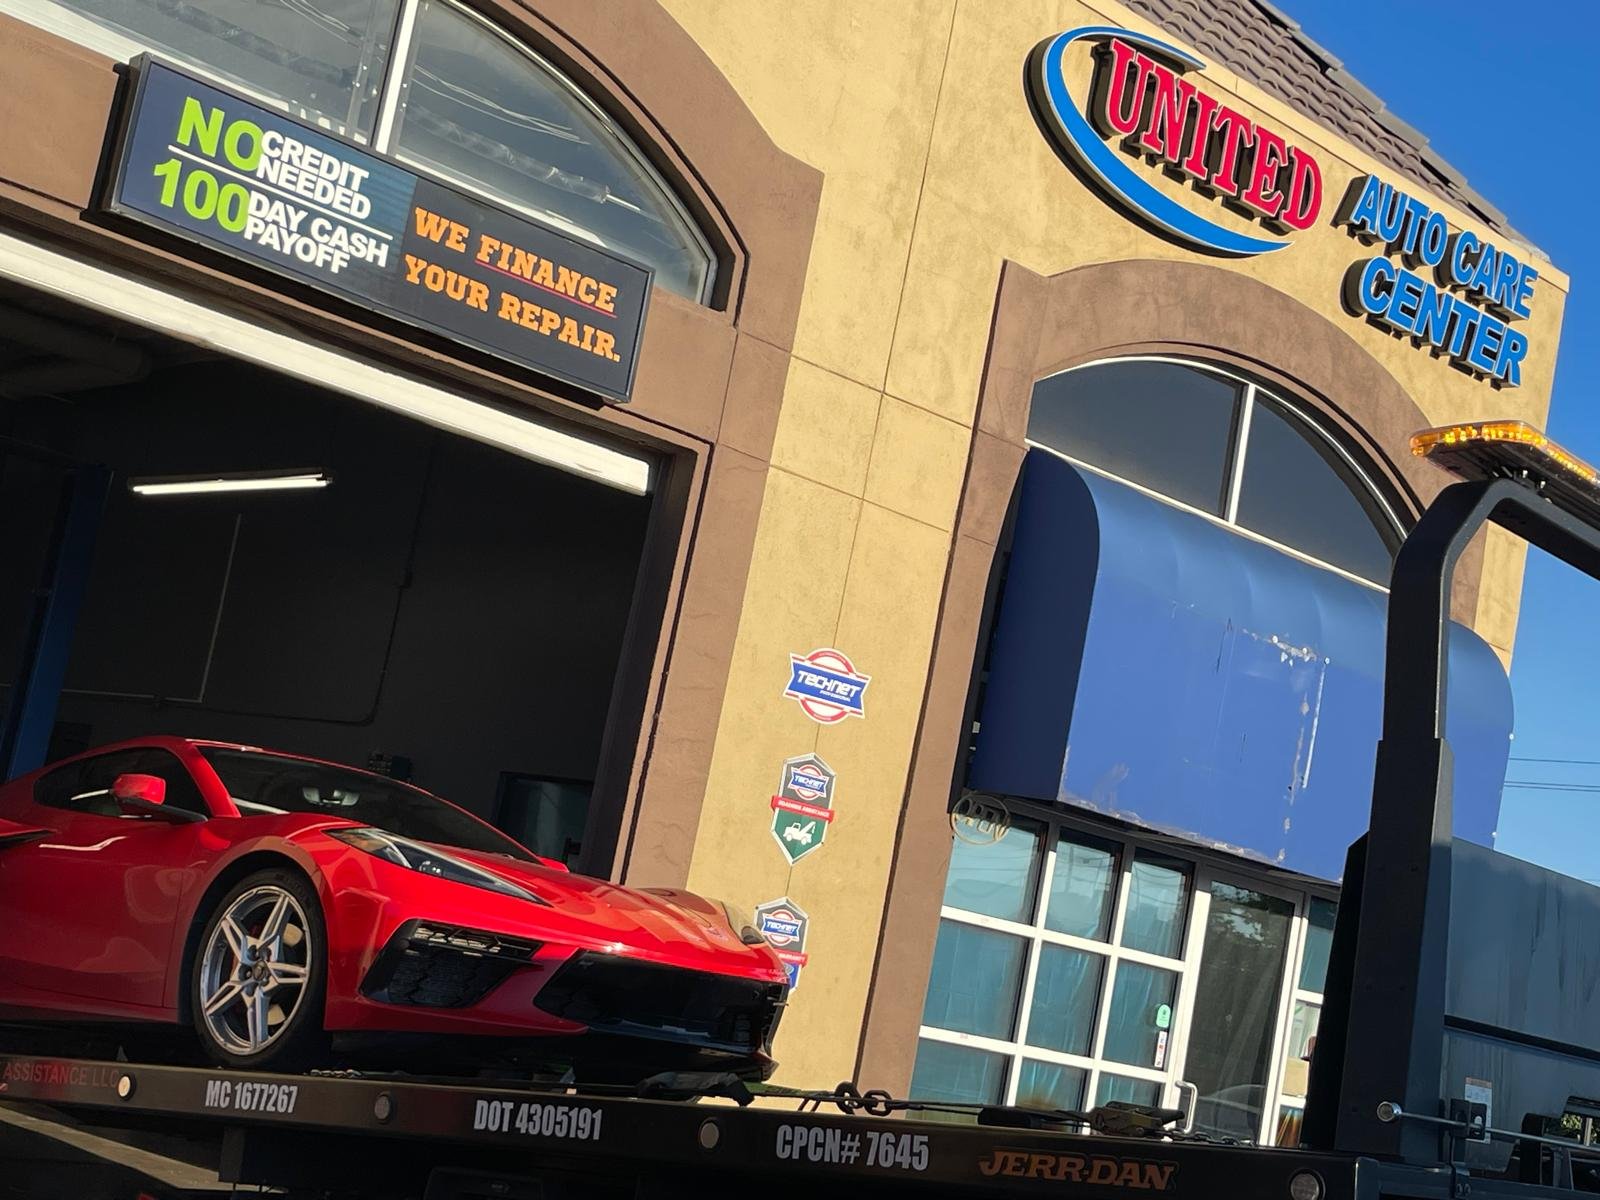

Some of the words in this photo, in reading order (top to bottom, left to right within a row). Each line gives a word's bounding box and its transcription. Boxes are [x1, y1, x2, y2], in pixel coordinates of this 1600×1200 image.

[177, 96, 263, 172] NO
[261, 129, 369, 191] CREDIT
[1105, 38, 1323, 231] UNITED
[153, 159, 250, 233] 100
[256, 154, 372, 220] NEEDED
[243, 217, 351, 274] PAYOFF
[248, 190, 308, 231] DAY
[311, 217, 390, 268] CASH
[414, 206, 470, 253] WE
[476, 233, 618, 313] FINANCE
[1352, 174, 1448, 267] AUTO
[1449, 229, 1539, 321] CARE
[404, 254, 489, 312] YOUR
[497, 292, 621, 362] REPAIR.
[1360, 256, 1529, 389] CENTER
[797, 670, 862, 699] TECHNET
[2, 1061, 87, 1086] ASSISTANCE
[92, 1067, 120, 1088] LLC
[205, 1080, 232, 1109] MC
[234, 1082, 298, 1114] 1677267
[473, 1099, 513, 1133] DOT
[515, 1103, 603, 1141] 4305191
[775, 1124, 861, 1165] CPCN#
[865, 1132, 930, 1171] 7645
[979, 1151, 1174, 1191] JERR-DAN
